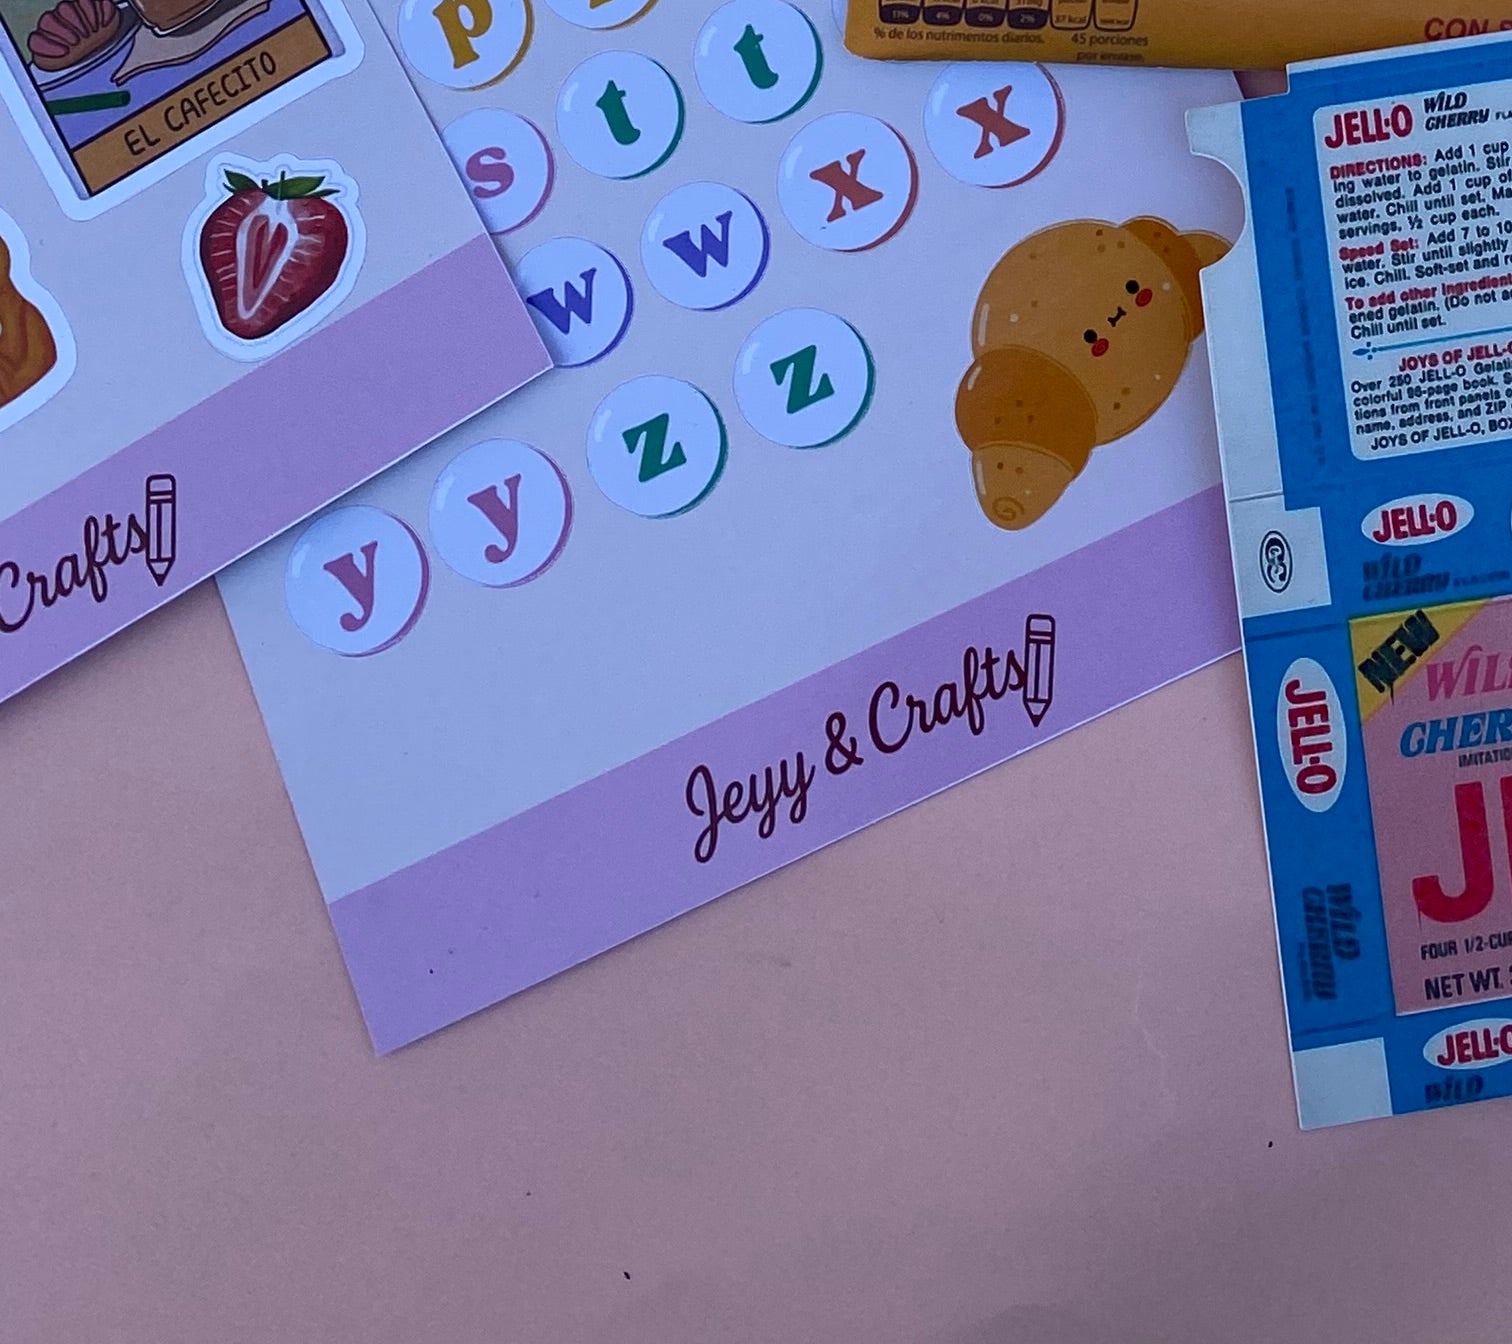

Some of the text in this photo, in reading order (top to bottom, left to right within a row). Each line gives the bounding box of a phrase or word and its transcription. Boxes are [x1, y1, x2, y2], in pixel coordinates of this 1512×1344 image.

[925, 30, 999, 43] nutrimentos
[1088, 34, 1148, 47] porciones
[595, 23, 779, 145] t t
[119, 46, 284, 160] EL CAFECITO
[1425, 108, 1489, 131] CHERRY
[1329, 141, 1509, 180] DIRECTIONS: Add cup
[1361, 173, 1401, 188] water
[1407, 170, 1422, 182] to
[1486, 154, 1510, 170] Stir
[662, 85, 1030, 277] w x x
[1413, 179, 1441, 196] Add
[1465, 175, 1491, 189] cup
[1424, 193, 1454, 210] until
[323, 344, 835, 632] y y z z
[1356, 607, 1443, 697] NEW
[685, 643, 1030, 863] Jeyy & Crafts
[1420, 940, 1458, 960] FOUR
[1424, 973, 1464, 1000] NET
[1468, 967, 1504, 993] WT.
